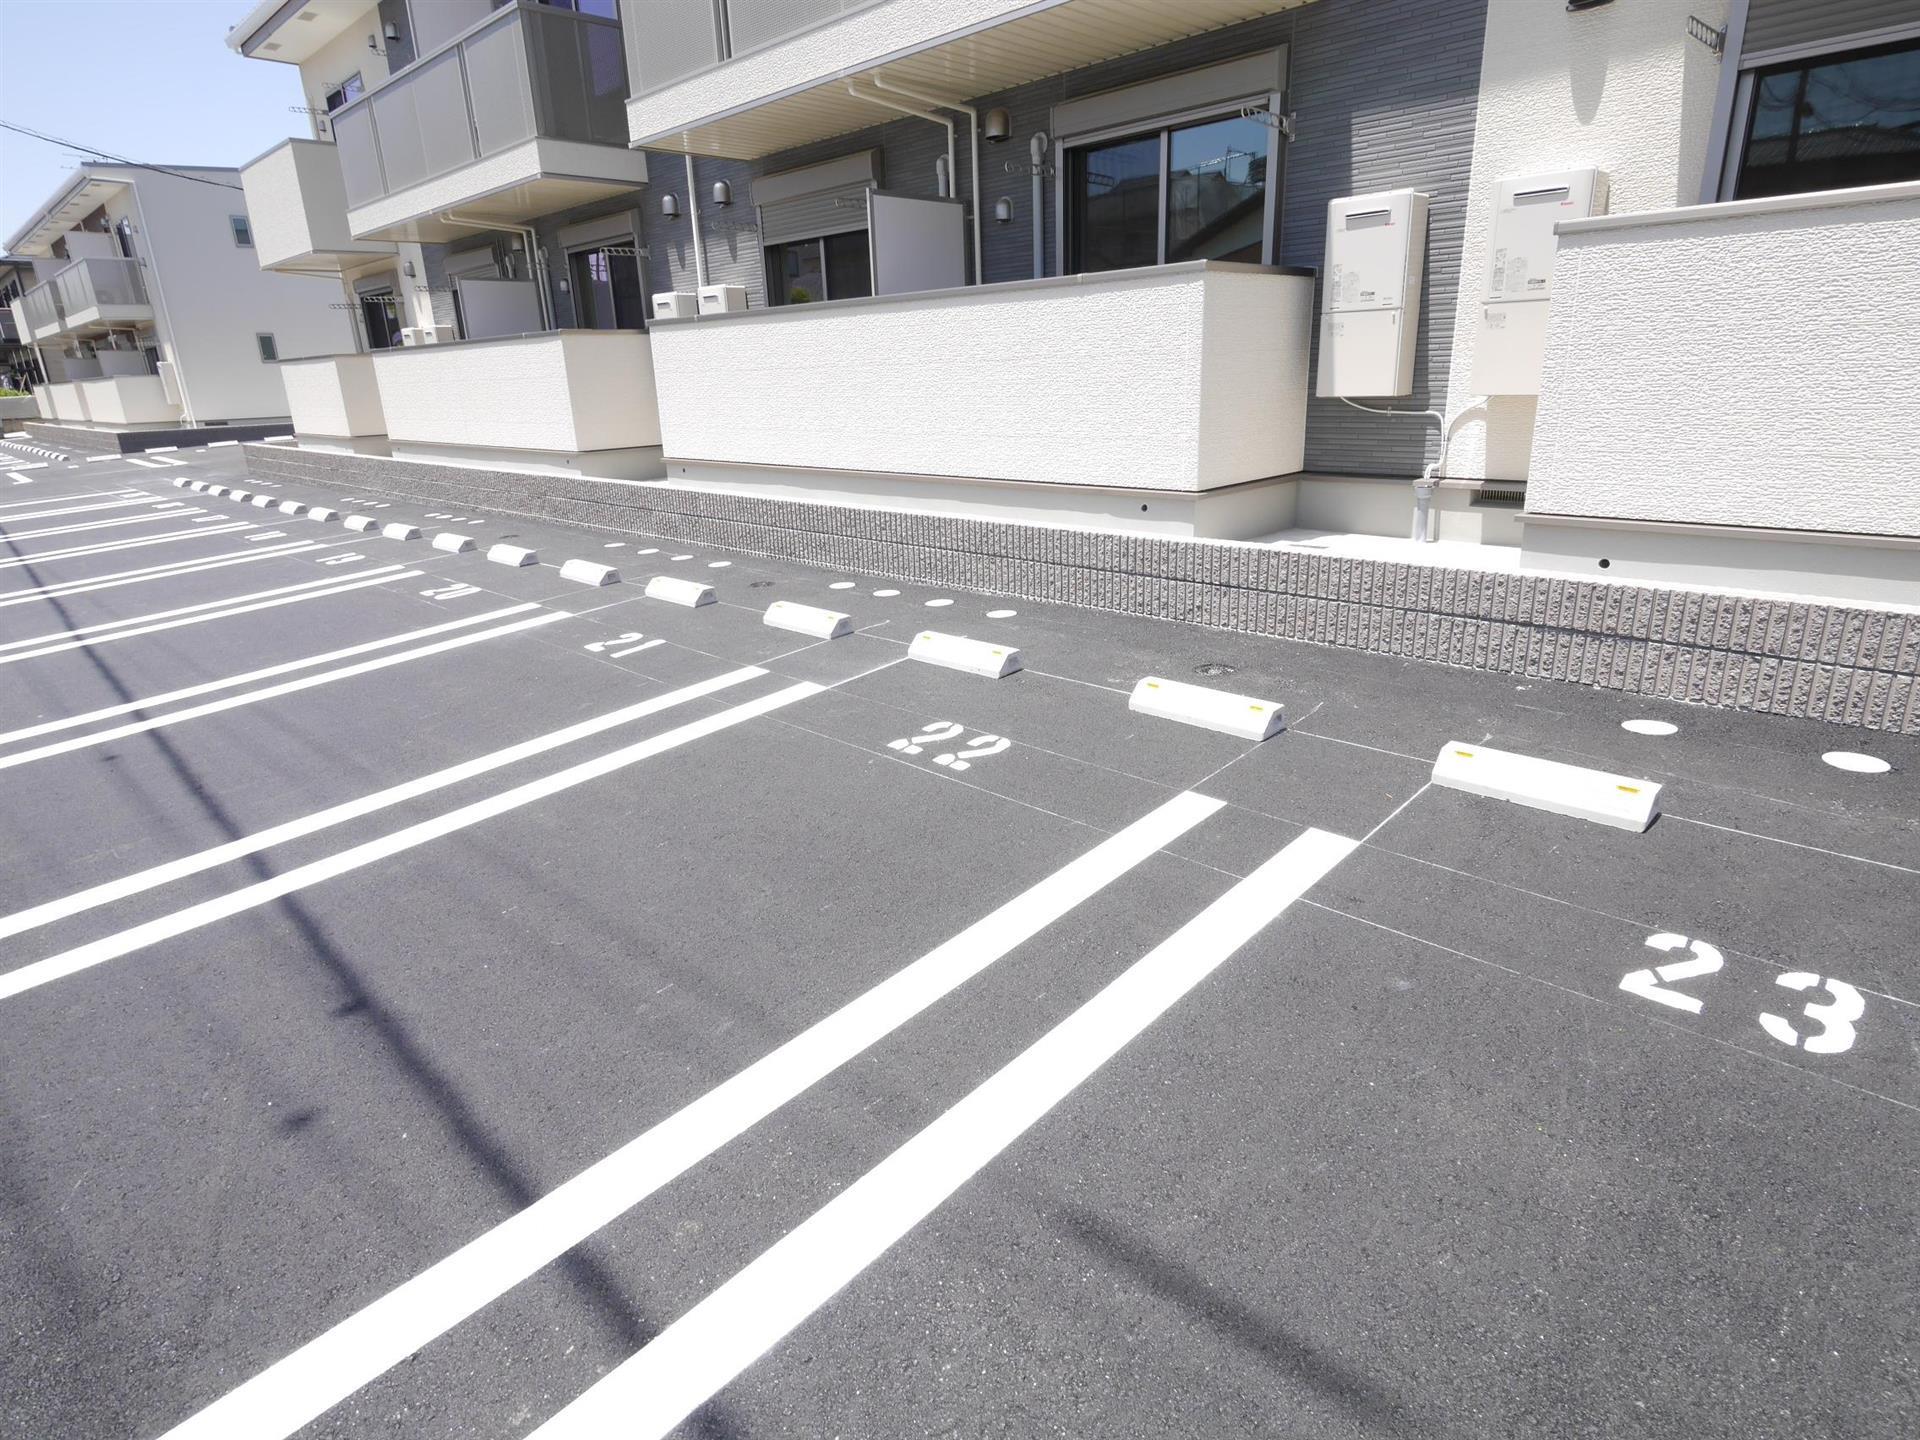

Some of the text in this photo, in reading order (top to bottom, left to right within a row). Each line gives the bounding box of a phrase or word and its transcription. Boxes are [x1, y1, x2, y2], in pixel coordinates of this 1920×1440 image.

[419, 583, 482, 600] 20
[584, 632, 667, 658] 21
[886, 721, 1011, 771] 22
[1618, 932, 1865, 1053] 23
